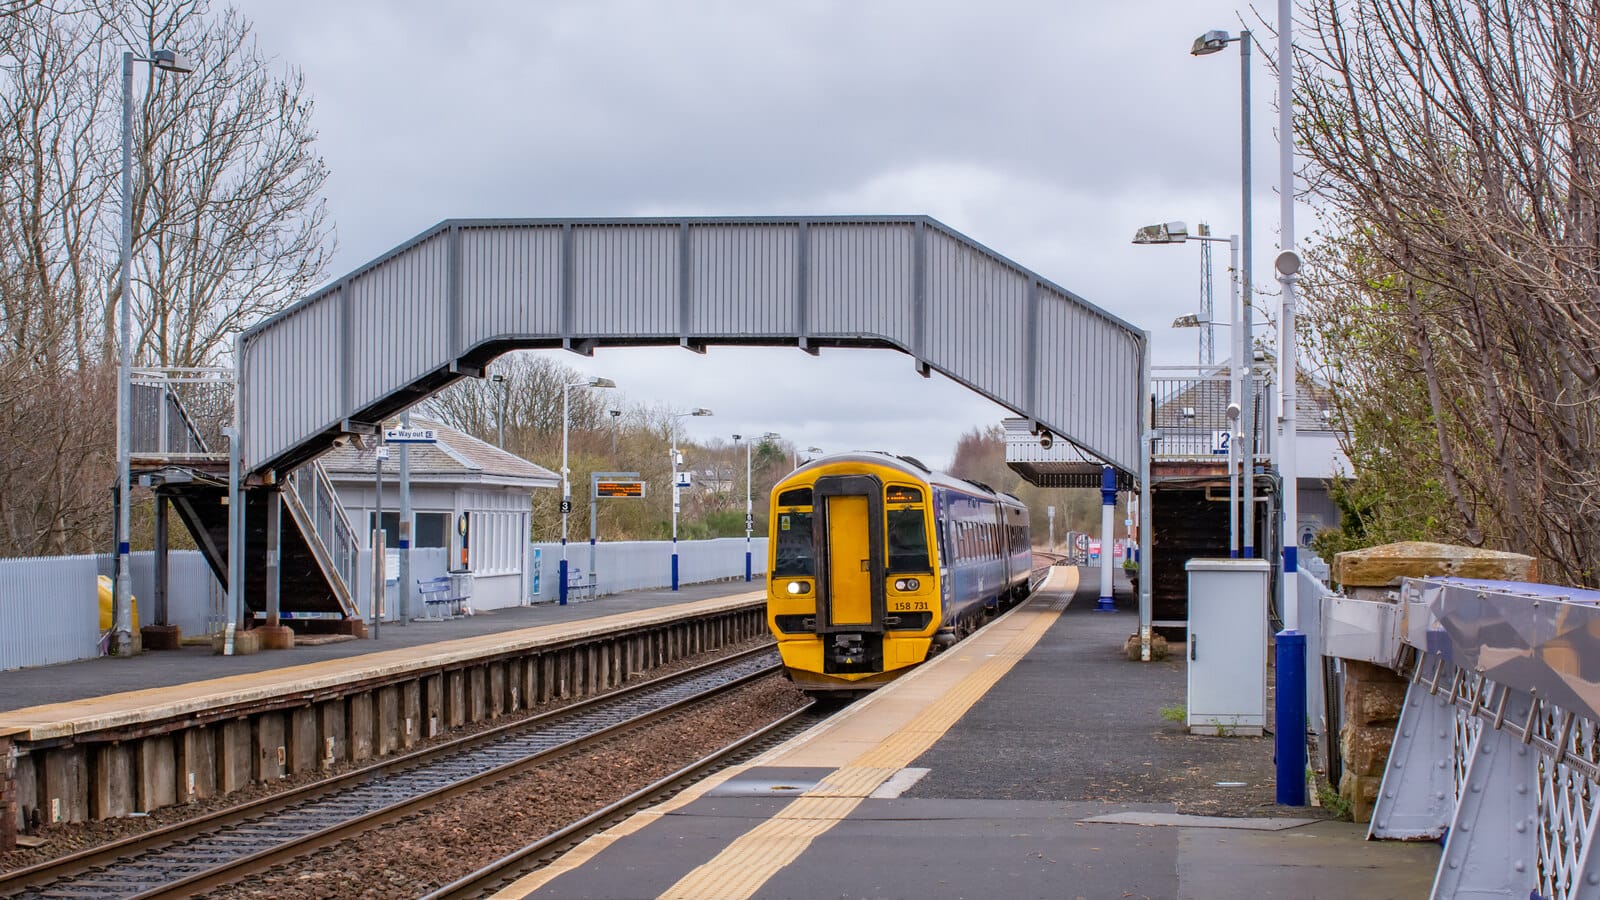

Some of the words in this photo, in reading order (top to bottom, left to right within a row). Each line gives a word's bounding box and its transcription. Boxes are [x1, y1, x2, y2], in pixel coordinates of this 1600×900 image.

[1221, 432, 1230, 448] 2
[680, 473, 686, 482] 1
[562, 502, 568, 510] 3
[895, 601, 911, 610] 158
[914, 601, 929, 610] 731
